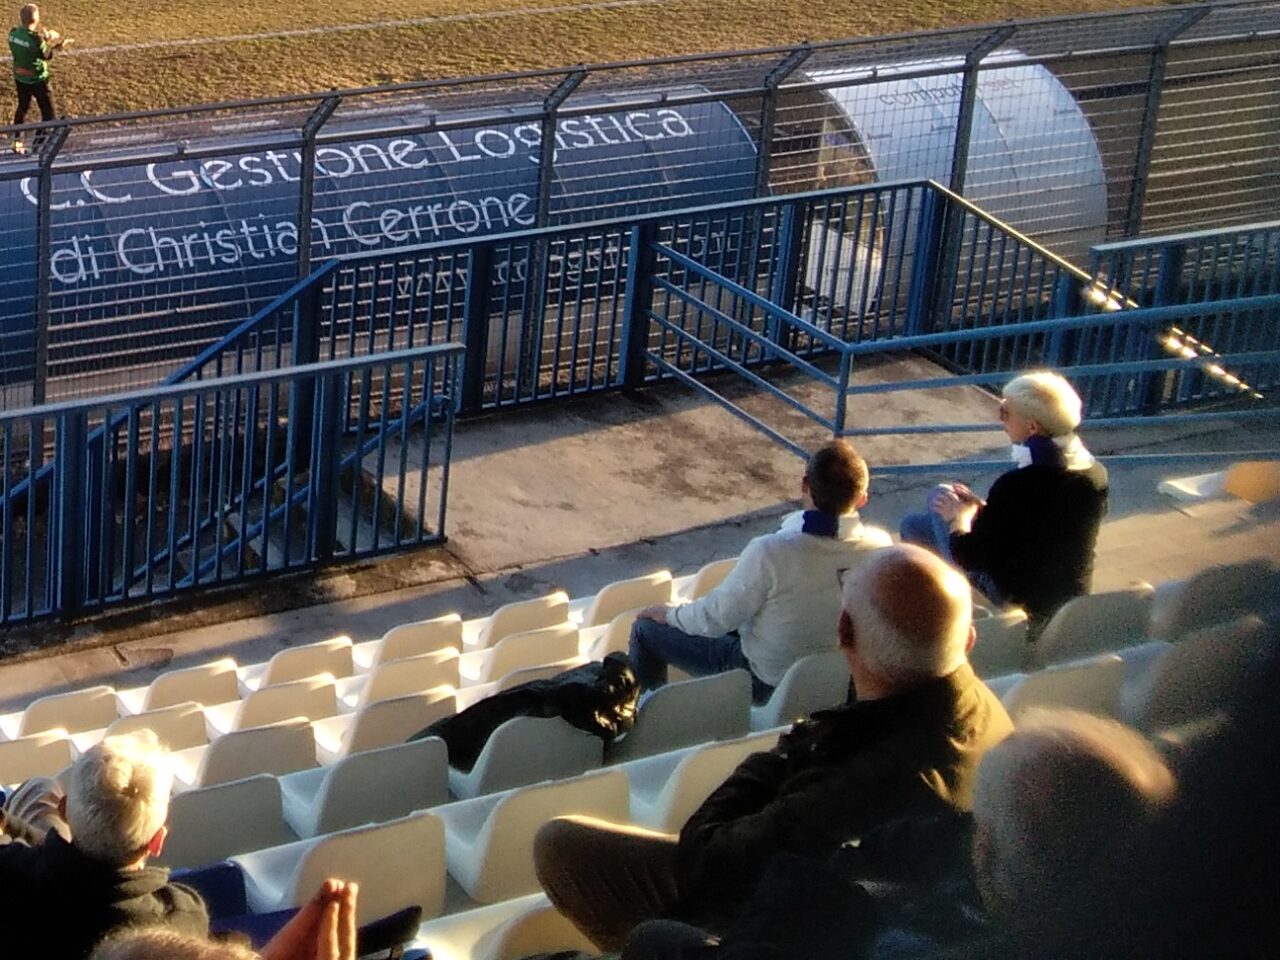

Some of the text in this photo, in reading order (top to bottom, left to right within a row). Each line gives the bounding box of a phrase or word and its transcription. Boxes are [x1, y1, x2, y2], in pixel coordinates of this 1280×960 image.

[437, 107, 696, 166] Logistica
[49, 233, 101, 285] di
[117, 211, 331, 274] Christian
[341, 192, 537, 247] Cerrone
